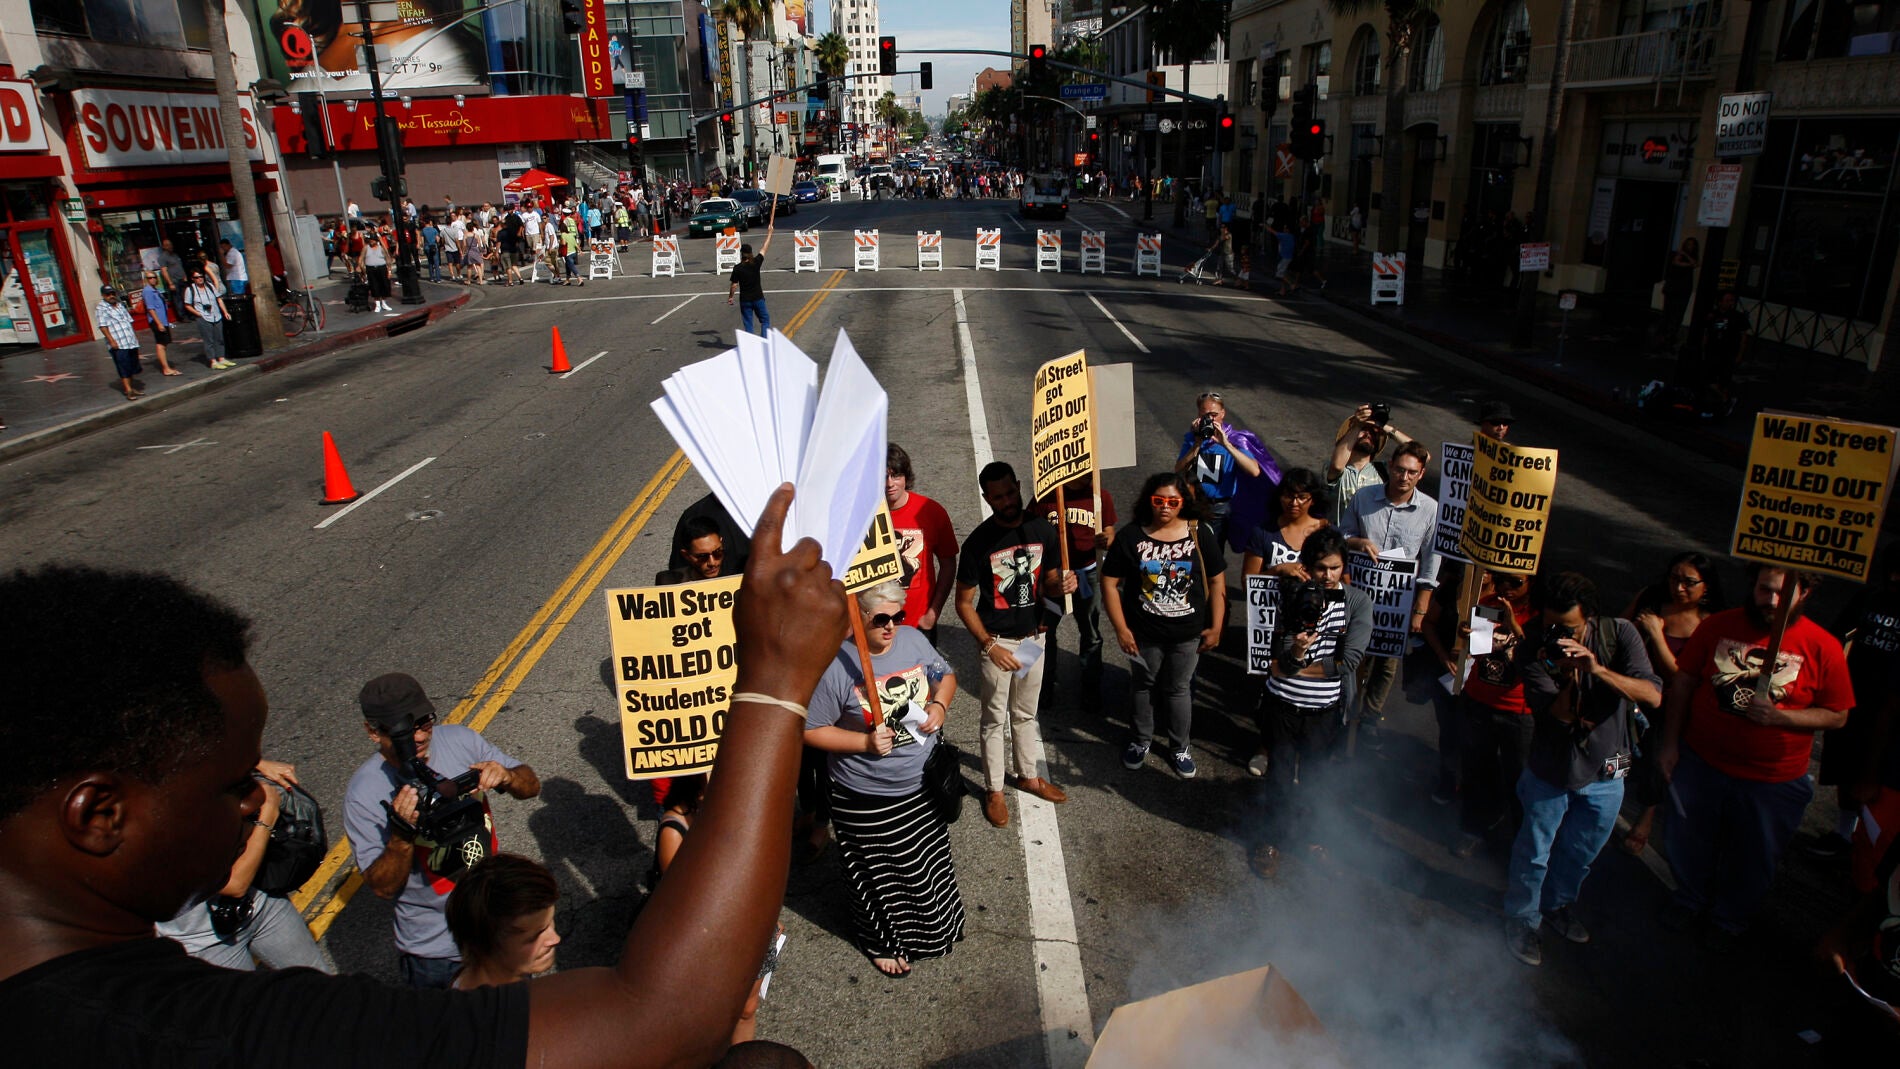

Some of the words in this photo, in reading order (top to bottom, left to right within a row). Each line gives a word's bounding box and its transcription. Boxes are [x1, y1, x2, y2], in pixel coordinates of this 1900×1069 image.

[385, 63, 408, 75] CT
[1064, 87, 1091, 97] Orange
[1093, 86, 1104, 95] Dr
[0, 88, 31, 143] D
[413, 110, 474, 133] Tussauds
[1722, 102, 1739, 117] DO
[1742, 100, 1768, 116] NOT
[81, 102, 257, 154] SOUVENIS
[1719, 121, 1765, 137] BLOCK
[1048, 359, 1083, 384] Street
[1045, 383, 1063, 405] got
[1034, 403, 1063, 437] BAILED
[1065, 395, 1087, 418] OUT
[1034, 427, 1070, 458] Students
[1072, 418, 1089, 439] got
[1763, 417, 1811, 443] Wall
[1813, 424, 1888, 453] Street
[1038, 448, 1061, 477] SOLD
[1062, 437, 1086, 461] OUT
[1196, 453, 1222, 483] N
[1444, 446, 1459, 458] We
[1460, 448, 1474, 461] De
[1478, 435, 1498, 462] Wall
[1498, 447, 1551, 471] Street
[1798, 449, 1838, 467] got
[1036, 459, 1091, 496] ANSWERLA.org
[1489, 466, 1514, 483] got
[1750, 464, 1829, 494] BAILED
[1832, 477, 1882, 502] OUT
[1473, 473, 1508, 505] BAILED
[1510, 491, 1548, 512] OUT
[1468, 495, 1512, 528] Students
[1514, 518, 1543, 533] got
[1747, 490, 1836, 520] Students
[1838, 509, 1876, 528] got
[1136, 541, 1154, 553] The
[1467, 517, 1493, 546] SOLD
[1495, 533, 1533, 552] OUT
[1749, 514, 1810, 543] SOLD
[1813, 525, 1863, 552] OUT
[1141, 540, 1196, 562] CLASH
[1739, 536, 1865, 576] ANSWERLA.org
[1250, 579, 1264, 588] We
[1349, 564, 1383, 588] NCEL
[1387, 573, 1413, 592] ALL
[616, 591, 676, 621] Wall
[1259, 608, 1275, 625] ST
[671, 617, 713, 648] got
[1253, 629, 1271, 645] DE
[620, 649, 713, 681] BAILED
[1251, 648, 1271, 657] Linds
[625, 685, 727, 714] Students
[637, 714, 708, 746] SOLD
